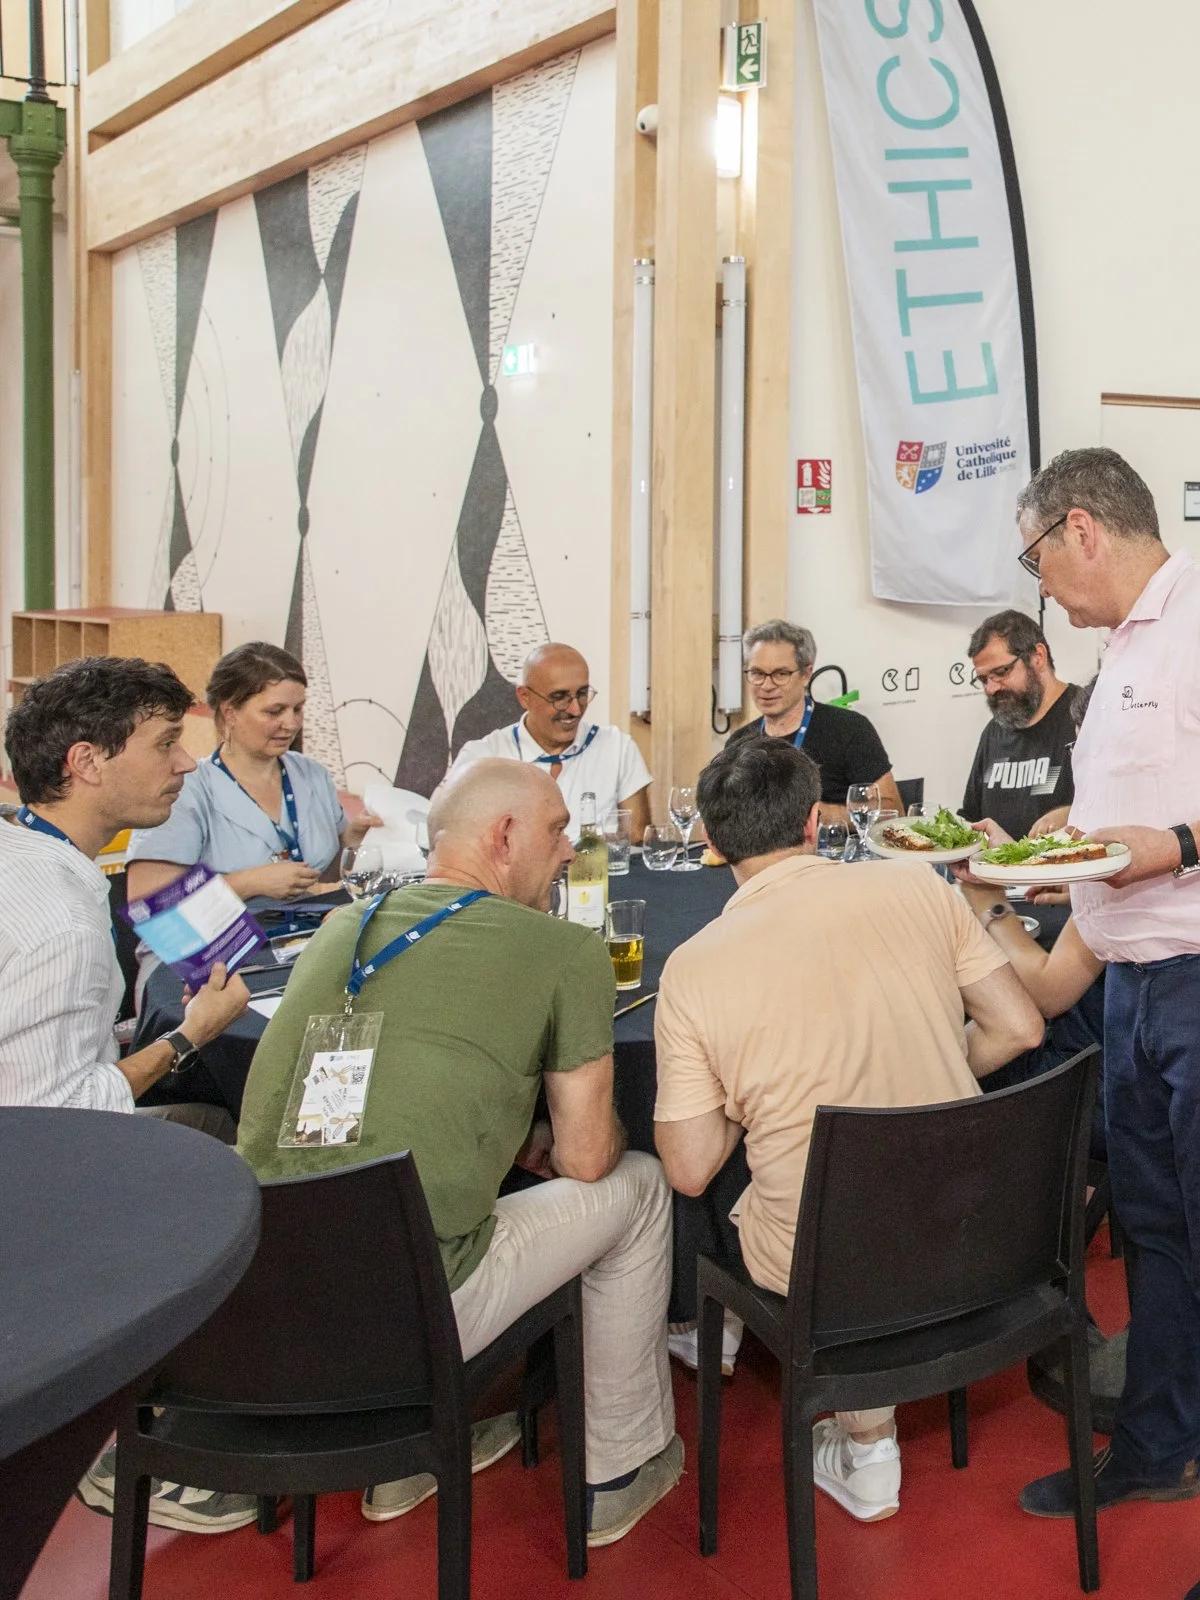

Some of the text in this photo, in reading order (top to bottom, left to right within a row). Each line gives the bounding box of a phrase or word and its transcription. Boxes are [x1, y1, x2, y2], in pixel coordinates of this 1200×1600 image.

[864, 0, 998, 404] ETHICS
[956, 449, 1017, 469] Catholique
[957, 470, 973, 481] de
[975, 465, 997, 479] Lille
[987, 757, 1051, 789] PUMA
